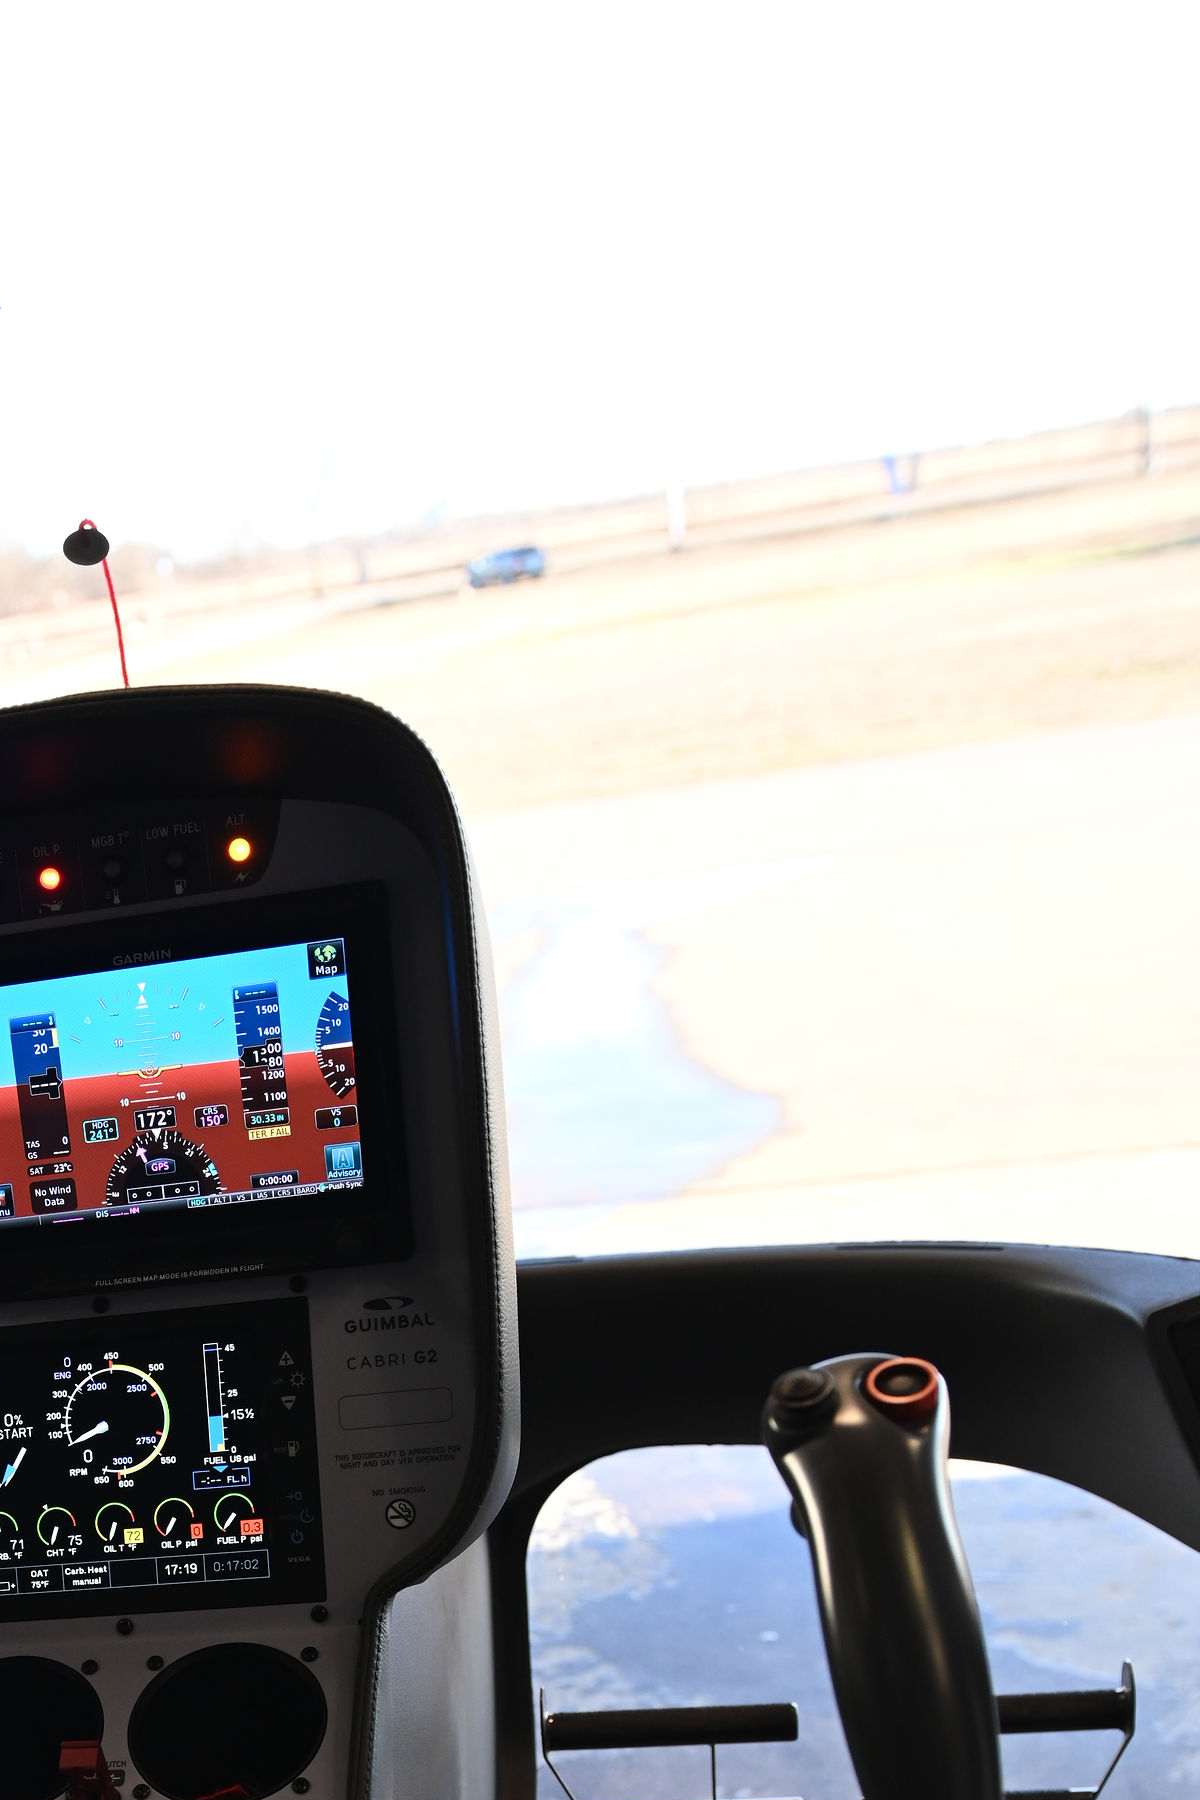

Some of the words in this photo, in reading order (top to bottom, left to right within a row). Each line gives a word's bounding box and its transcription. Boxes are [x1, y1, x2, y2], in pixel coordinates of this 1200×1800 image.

[145, 826, 169, 841] LOW
[173, 821, 201, 837] FUEL
[33, 844, 49, 858] OIL
[113, 949, 171, 966] GARMIN
[315, 965, 338, 975] Map
[256, 1004, 278, 1014] 1500
[258, 1026, 280, 1036] 1400
[34, 1043, 47, 1055] 20
[262, 1070, 284, 1080] 1200
[264, 1092, 286, 1101] 1100
[203, 1106, 218, 1115] CRS
[138, 1110, 172, 1129] 172°
[251, 1113, 275, 1124] 30.33
[91, 1121, 108, 1129] HDG
[250, 1131, 267, 1139] TER
[270, 1128, 290, 1137] FAIL
[26, 1140, 40, 1148] TAS
[62, 1136, 69, 1145] 0
[29, 1167, 43, 1175] SAT
[151, 1162, 169, 1171] GPS
[259, 1175, 293, 1186] 0:00:00
[328, 1170, 361, 1180] Advisory
[35, 1188, 46, 1197] No
[49, 1185, 71, 1195] Wind
[328, 1182, 345, 1191] Push
[345, 1180, 362, 1190] Sync
[191, 1198, 205, 1206] HDG
[213, 1196, 227, 1204] ALT
[236, 1194, 246, 1202] VS
[297, 1186, 315, 1194] BARO
[44, 1197, 64, 1207] Data
[95, 1279, 113, 1287] FULL
[113, 1276, 141, 1285] SCREEN
[142, 1274, 158, 1282] MAP
[160, 1272, 180, 1281] MODE
[189, 1267, 230, 1278] FORBIDDEN
[230, 1266, 238, 1274] IN
[239, 1263, 264, 1272] FLIGHT
[345, 1312, 435, 1333] GUIMBAL
[347, 1353, 405, 1369] CABRI
[414, 1350, 437, 1363] G2
[53, 1371, 72, 1380] ENG
[87, 1382, 107, 1391] 2000
[3, 1413, 23, 1427] 0%
[352, 1450, 396, 1460] ROTORCRAFT
[408, 1446, 445, 1456] APPROVED
[204, 1456, 226, 1465] FUEL
[229, 1455, 241, 1463] US
[243, 1454, 257, 1463] gal
[340, 1462, 360, 1470] NIGHT
[363, 1460, 378, 1468] AND
[415, 1454, 456, 1464] OPERATION
[69, 1468, 88, 1477] RPM
[389, 1486, 426, 1495] SMOKING
[243, 1522, 261, 1532] 0.3
[161, 1541, 174, 1549] OIL
[185, 1539, 198, 1549] psi
[217, 1536, 239, 1545] FUEL
[250, 1535, 263, 1544] psi
[46, 1548, 64, 1557] CHT
[65, 1568, 86, 1576] Carb.
[88, 1565, 107, 1574] Heat
[165, 1562, 197, 1575] 17:19
[213, 1559, 259, 1572] 0:17:02
[30, 1569, 49, 1577] OAT
[72, 1577, 101, 1586] manual
